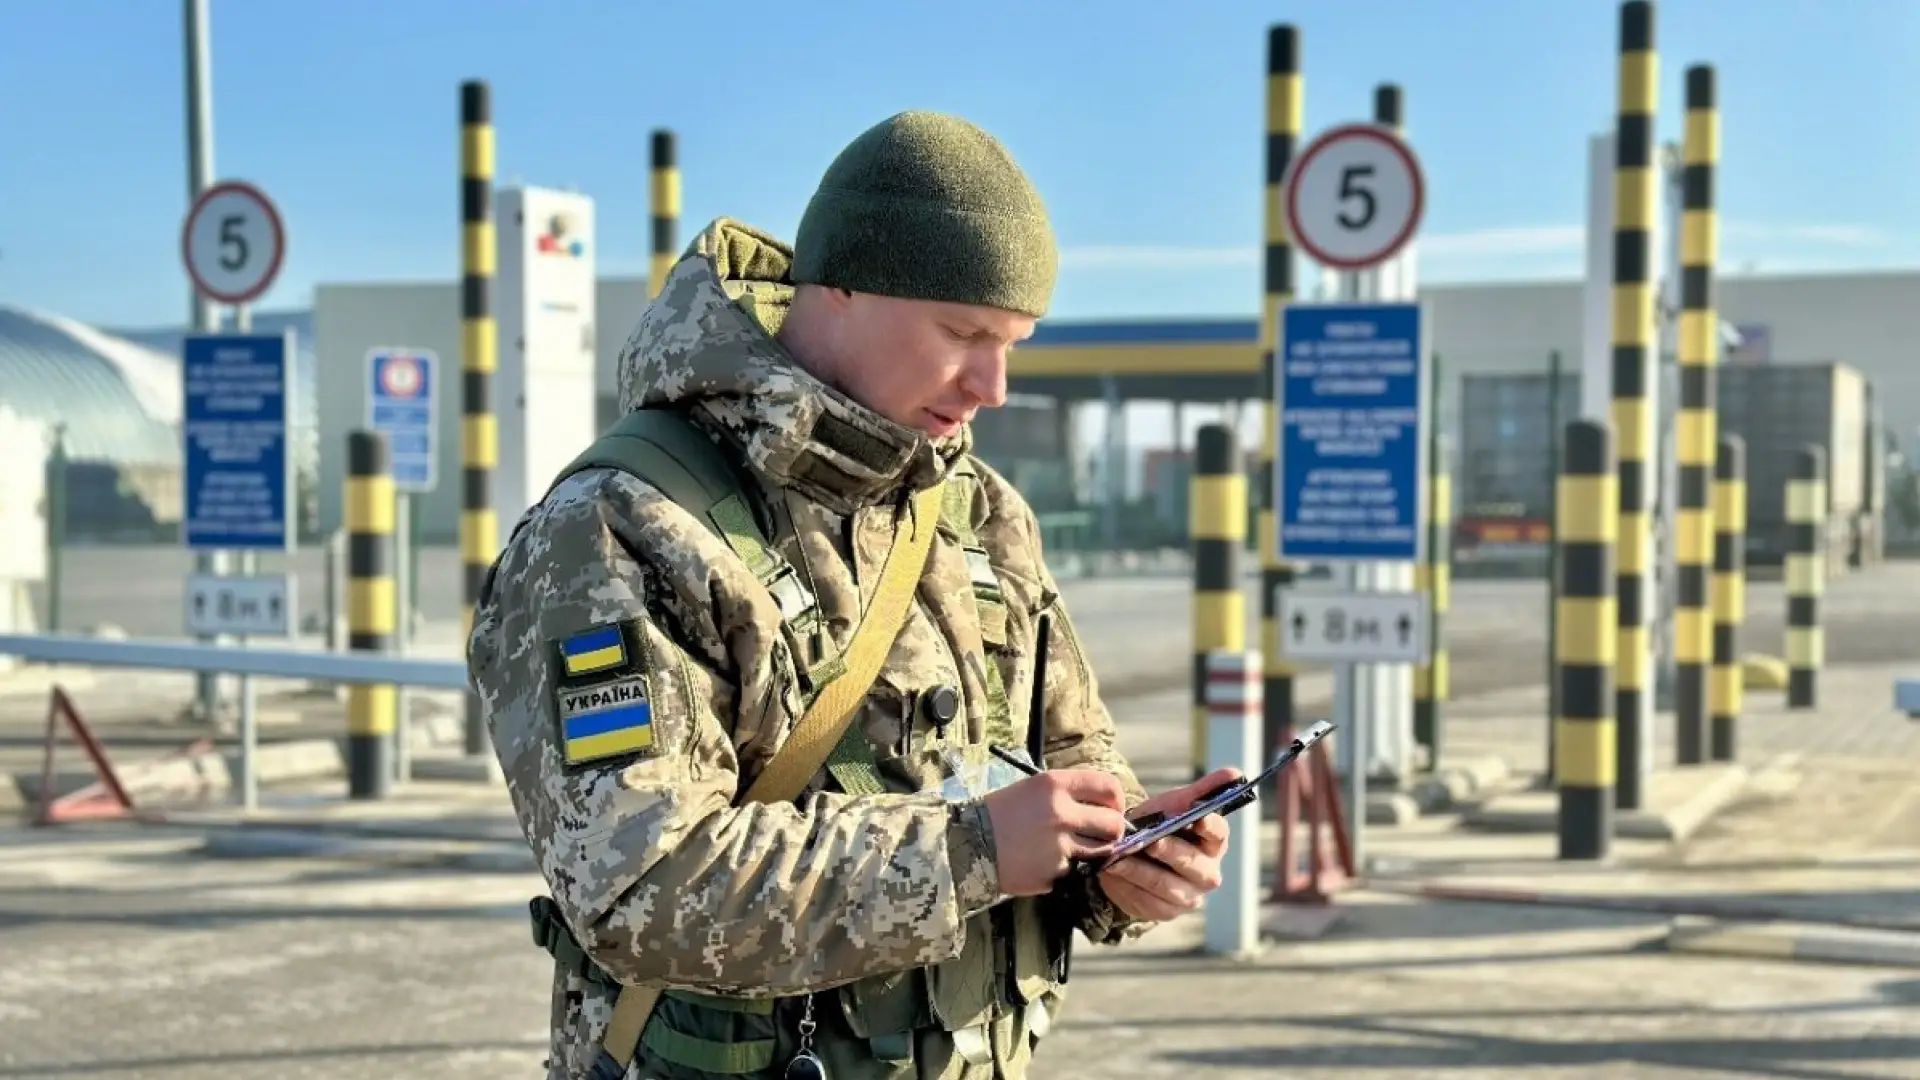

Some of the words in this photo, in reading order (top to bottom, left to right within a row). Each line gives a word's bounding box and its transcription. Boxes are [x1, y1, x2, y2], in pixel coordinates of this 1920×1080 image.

[1336, 162, 1377, 232] 5
[218, 213, 249, 273] 5
[566, 685, 643, 711] УКРАЇНА
